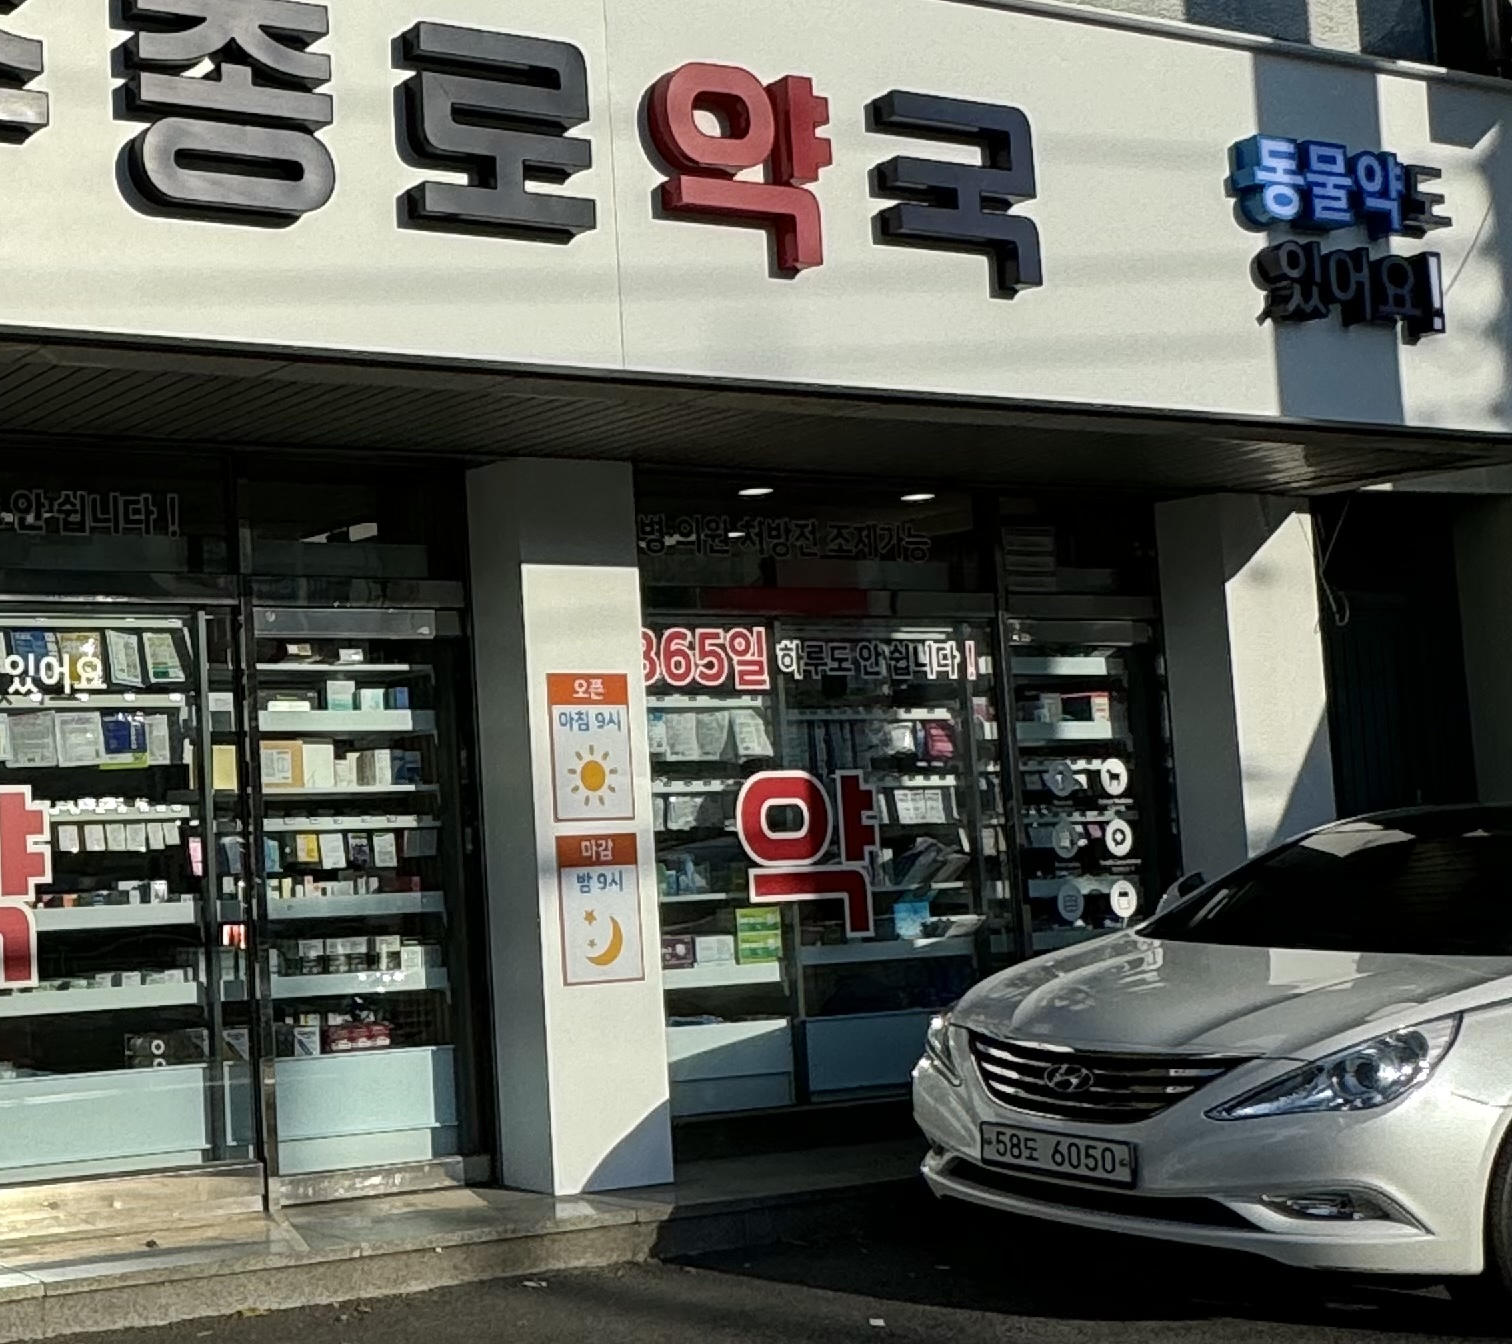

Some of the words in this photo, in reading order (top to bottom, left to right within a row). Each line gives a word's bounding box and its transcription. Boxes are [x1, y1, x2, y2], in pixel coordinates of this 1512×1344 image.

[1263, 241, 1445, 340] 있어요!
[4, 652, 108, 695] 있어요
[775, 639, 856, 681] 하루도
[572, 678, 605, 701] 오픈
[558, 710, 590, 733] 아침
[595, 709, 622, 733] 9시
[580, 838, 614, 861] 마감
[736, 770, 881, 938] 약
[576, 871, 593, 894] 밤
[596, 869, 624, 892] 9시
[995, 1130, 1039, 1162] 58도
[1051, 1140, 1116, 1175] 6050
